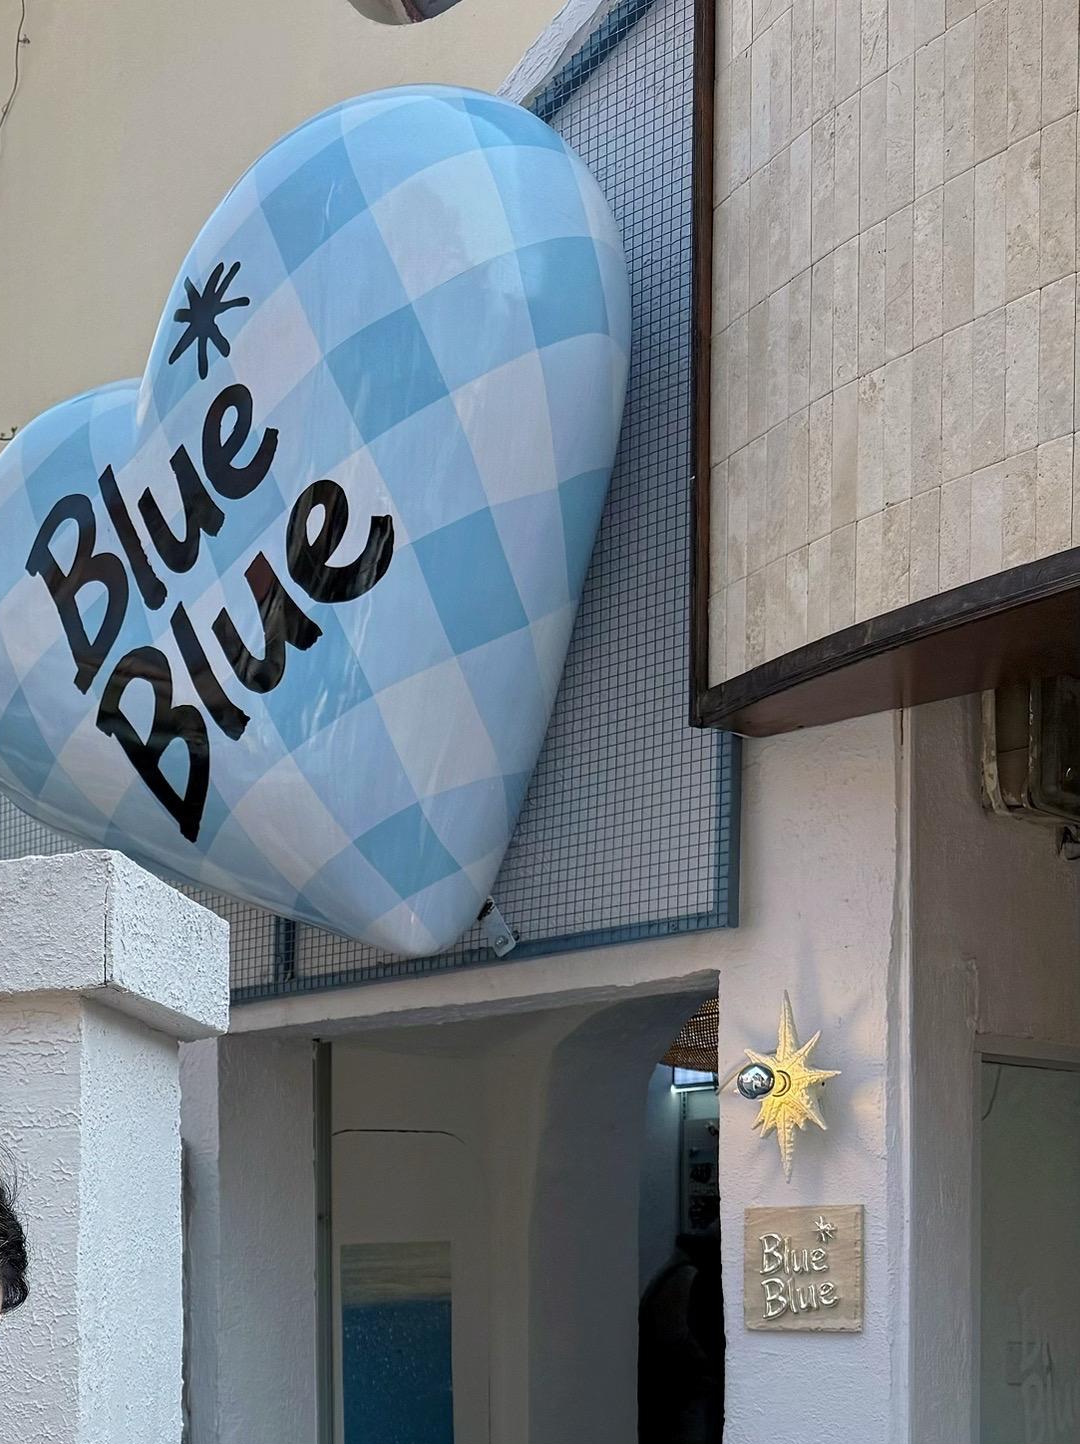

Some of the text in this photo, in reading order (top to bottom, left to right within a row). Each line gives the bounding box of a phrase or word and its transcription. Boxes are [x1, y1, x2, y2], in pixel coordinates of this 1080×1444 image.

[26, 383, 279, 694] Blue
[95, 479, 393, 843] Blue
[759, 1233, 829, 1275] Blue
[761, 1277, 839, 1320] Blue
